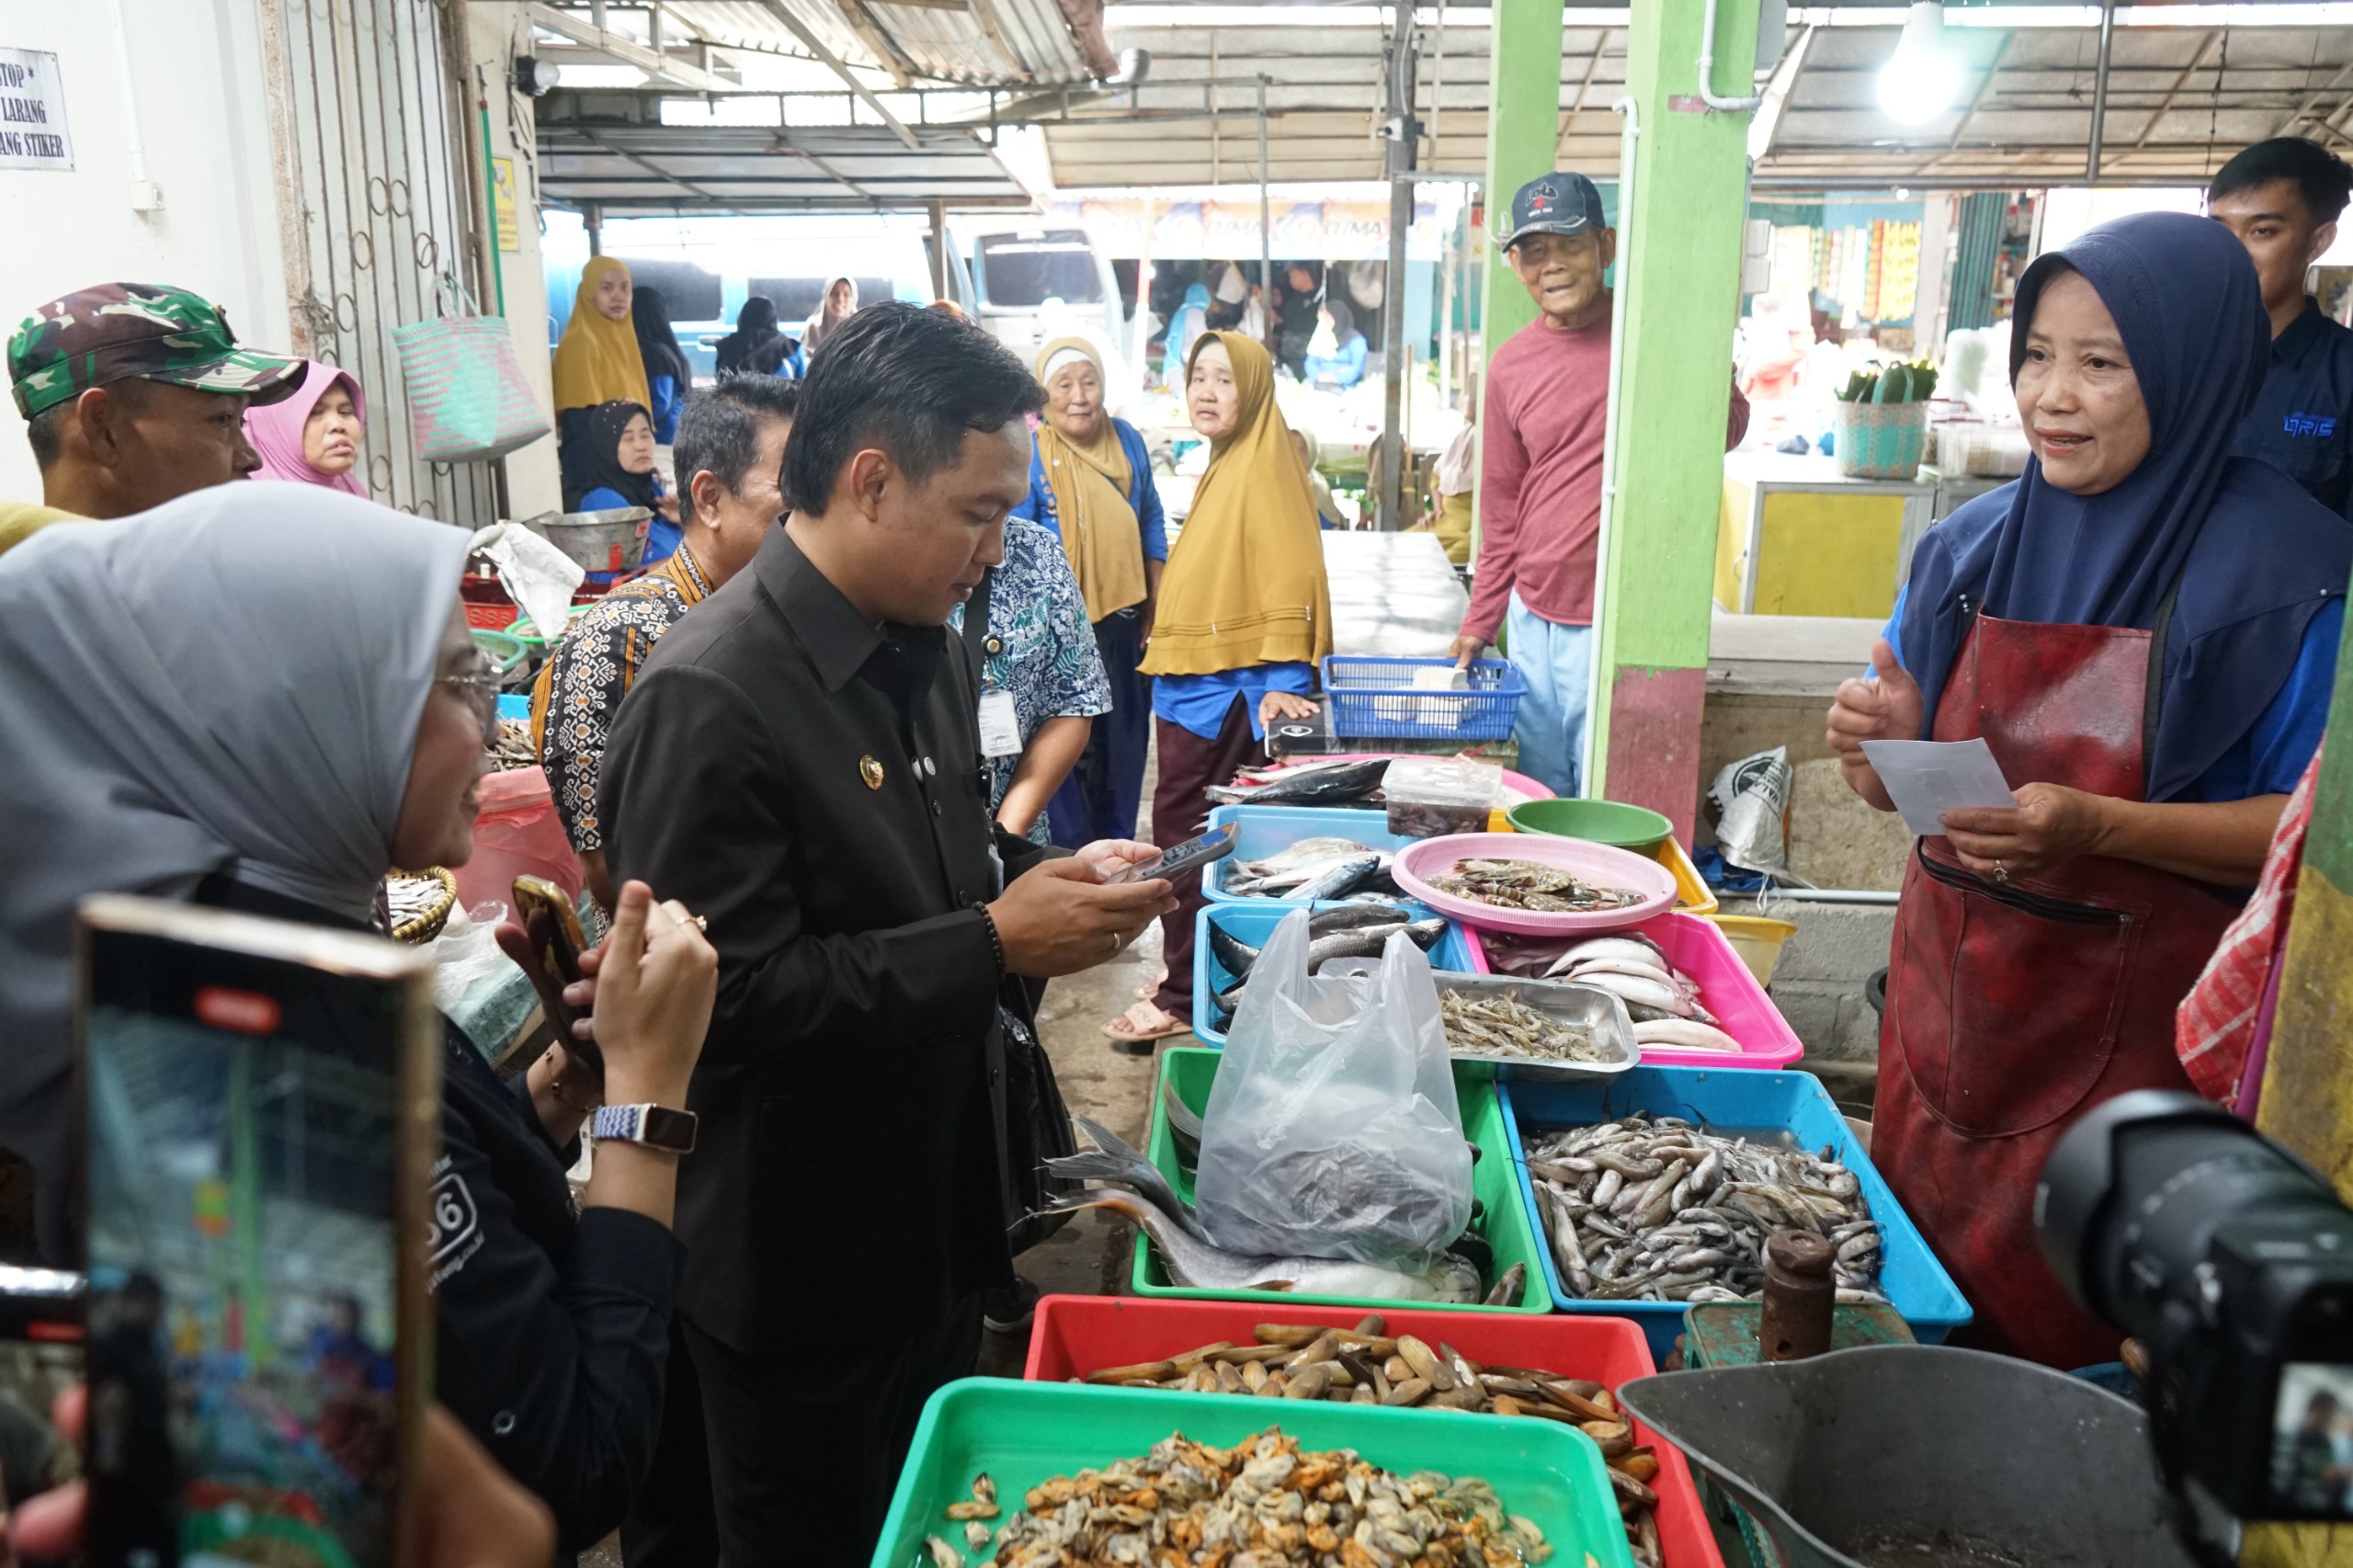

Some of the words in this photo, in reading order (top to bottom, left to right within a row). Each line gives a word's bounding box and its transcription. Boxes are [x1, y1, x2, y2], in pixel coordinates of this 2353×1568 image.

[0, 62, 25, 88] TOP
[1, 97, 47, 124] LARANG
[24, 132, 65, 158] STIKER
